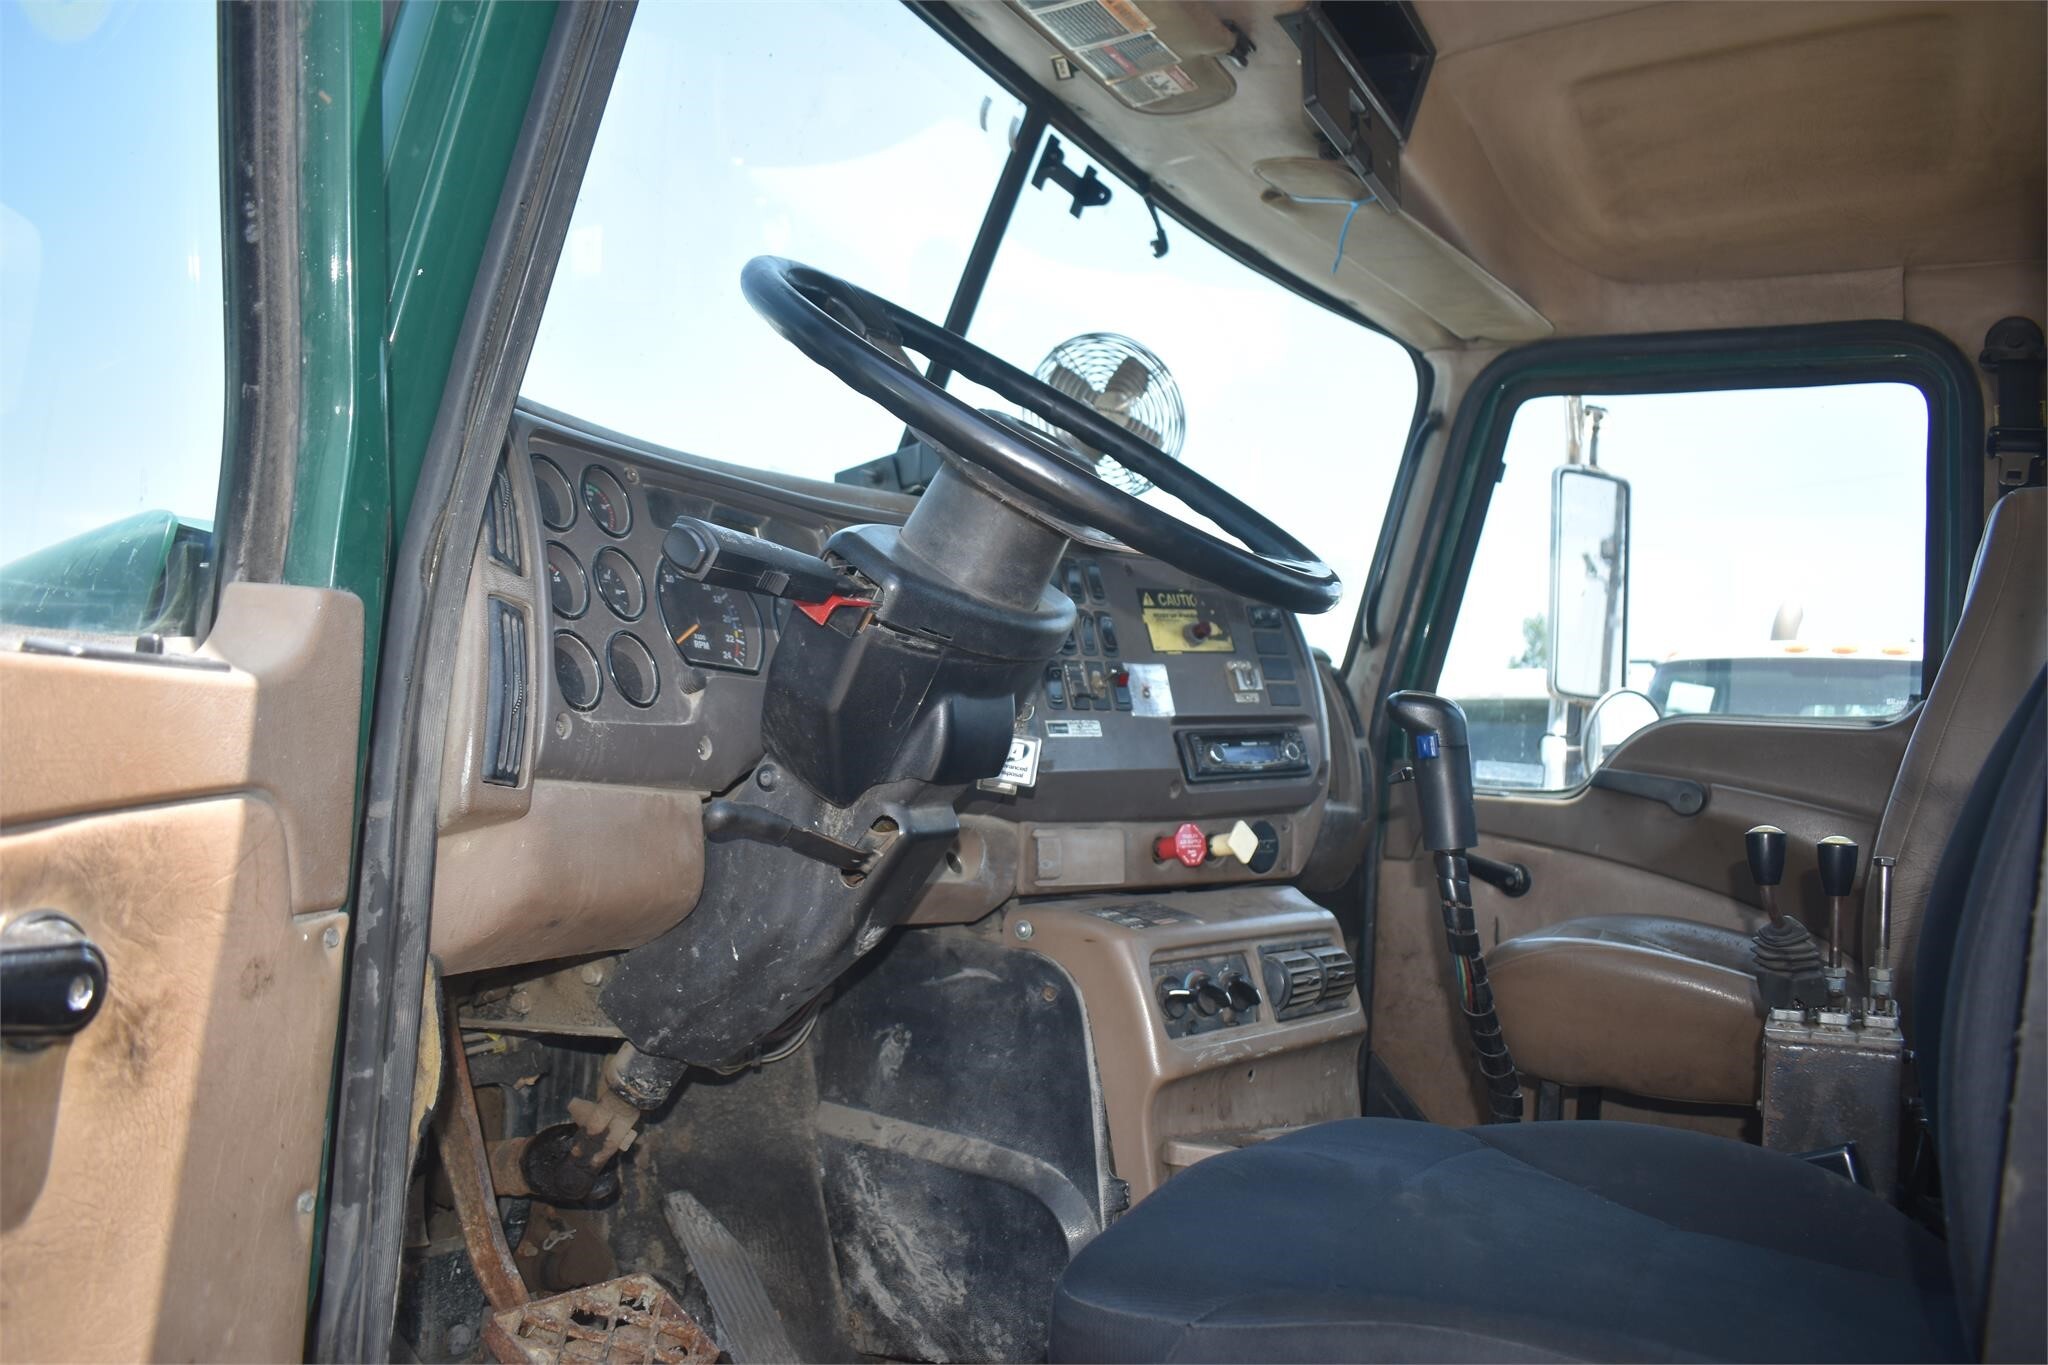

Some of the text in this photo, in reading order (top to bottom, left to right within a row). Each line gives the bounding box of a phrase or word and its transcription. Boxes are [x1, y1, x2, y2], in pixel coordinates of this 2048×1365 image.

[1157, 592, 1198, 608] CAUTIO
[725, 633, 735, 643] 22
[693, 640, 711, 651] RPM
[722, 650, 733, 660] 24
